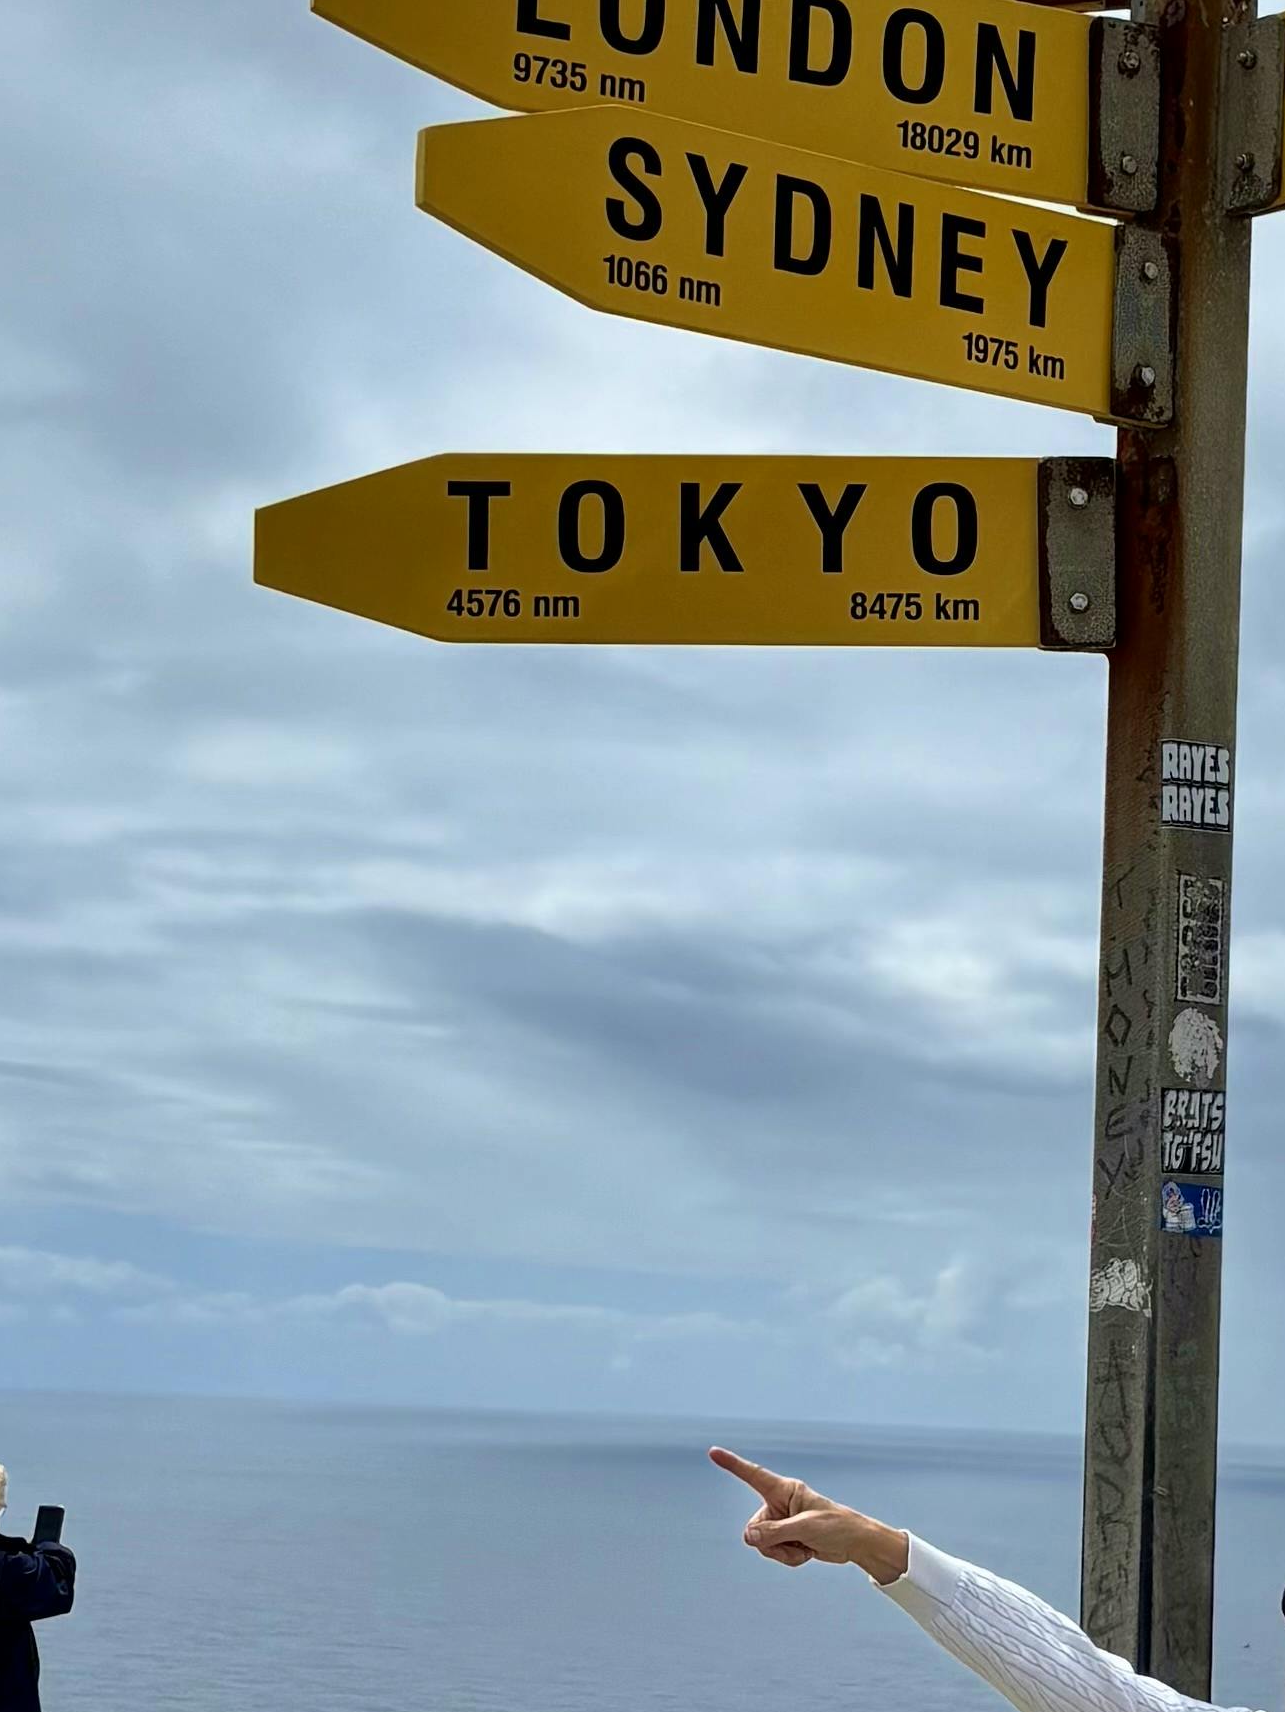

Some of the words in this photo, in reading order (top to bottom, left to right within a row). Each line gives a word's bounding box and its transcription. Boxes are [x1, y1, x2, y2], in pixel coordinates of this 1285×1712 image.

[512, 51, 589, 94] 9735
[598, 72, 647, 104] nm
[895, 118, 981, 160] 18029
[989, 133, 1033, 170] km
[604, 135, 1070, 330] SYDNEY
[602, 252, 669, 296] 1066
[677, 275, 722, 308] nm
[960, 330, 1020, 371] 1975
[1027, 344, 1066, 381] km
[447, 478, 979, 577] TOKYO
[446, 587, 522, 619] 4576
[532, 594, 581, 619] nm
[849, 590, 924, 622] 8475
[934, 591, 981, 622] km
[1161, 742, 1230, 784] RAYES
[1161, 785, 1230, 826] RAYES
